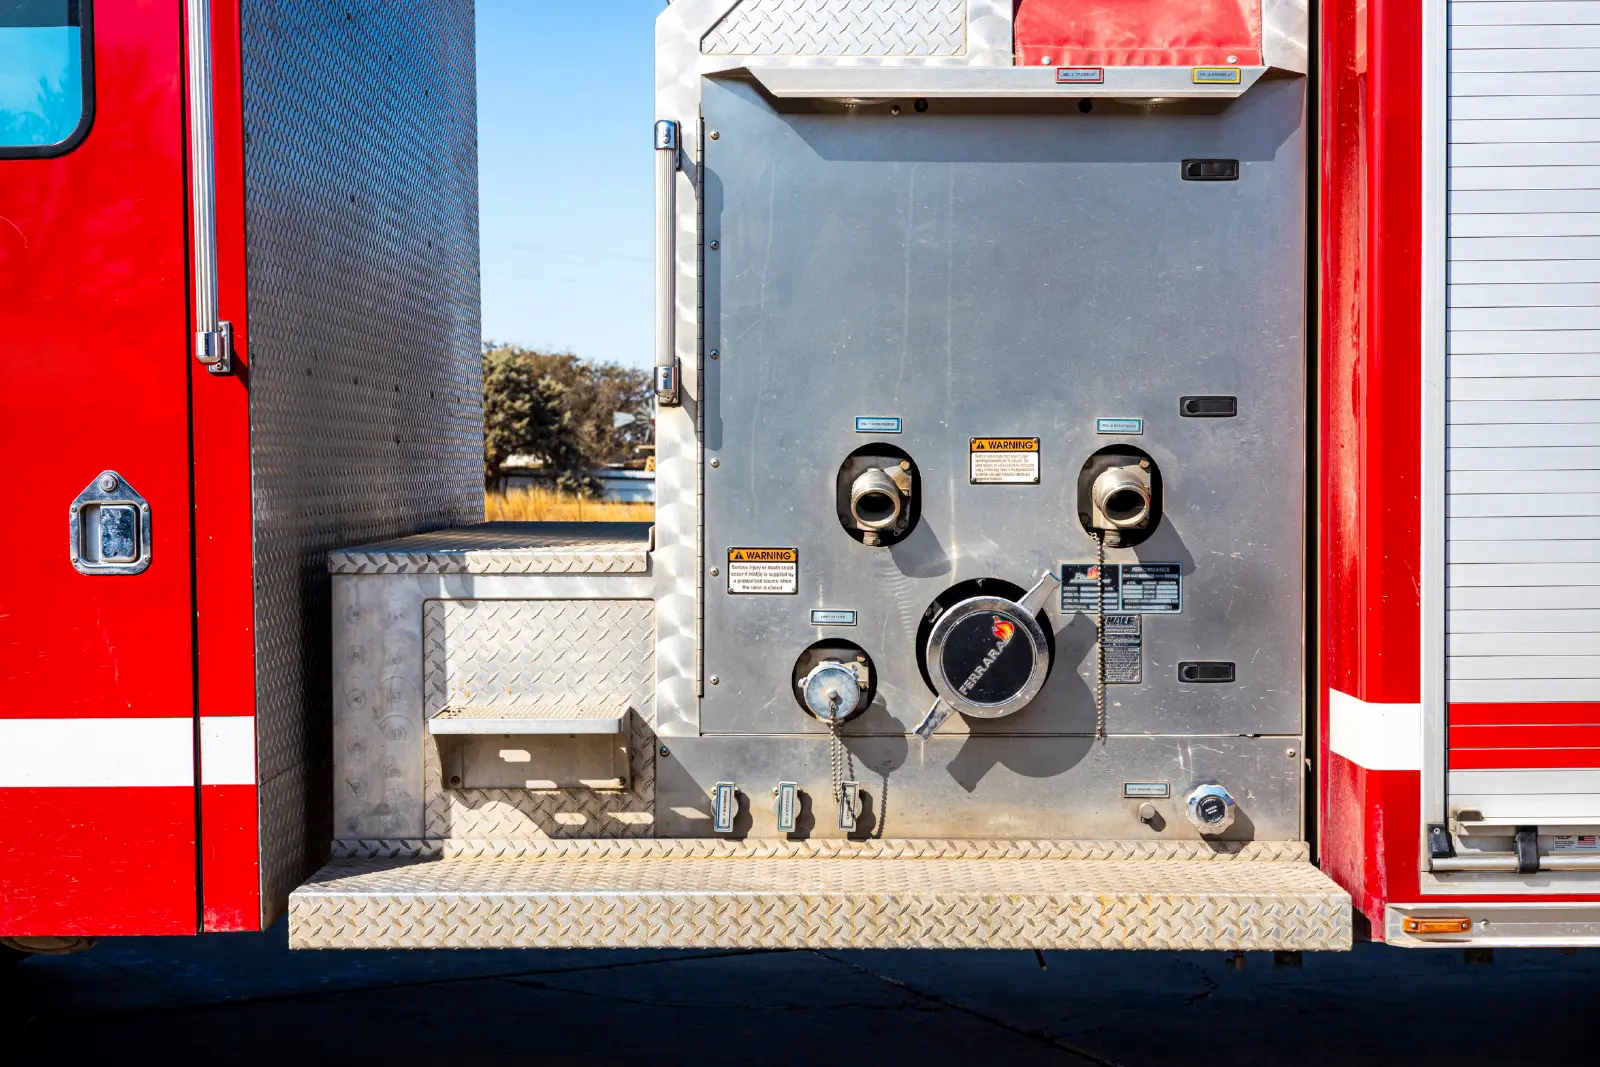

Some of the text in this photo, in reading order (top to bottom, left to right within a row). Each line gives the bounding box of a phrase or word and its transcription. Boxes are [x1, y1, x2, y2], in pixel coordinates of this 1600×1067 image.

[988, 441, 1033, 449] WARNING
[746, 551, 792, 560] WARNING
[1106, 616, 1134, 625] HALE
[958, 640, 1008, 696] FERRARA
